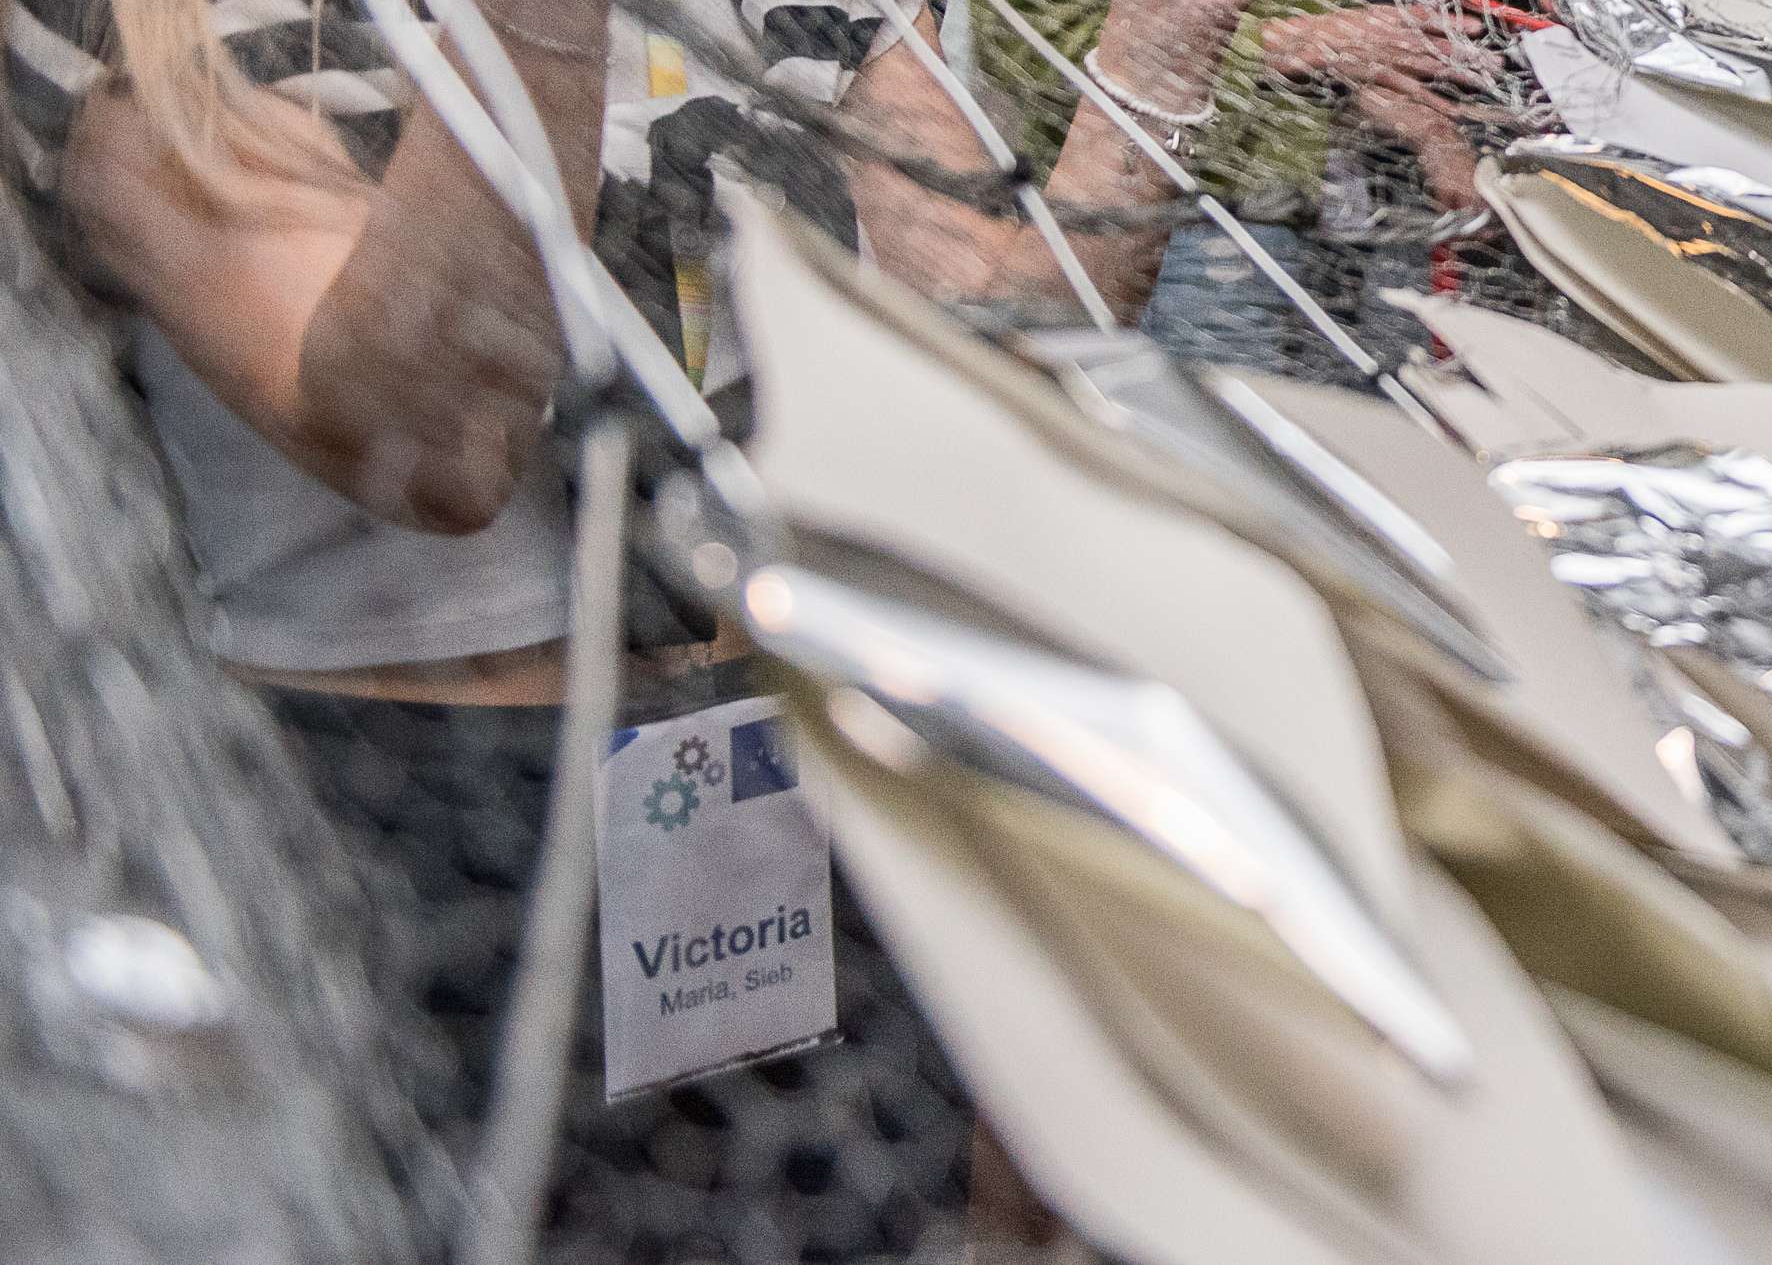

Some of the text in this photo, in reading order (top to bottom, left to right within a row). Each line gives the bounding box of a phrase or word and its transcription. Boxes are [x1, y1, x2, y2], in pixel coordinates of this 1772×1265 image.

[631, 905, 811, 980] Victoria
[659, 962, 794, 1018] Maria, Sieb
